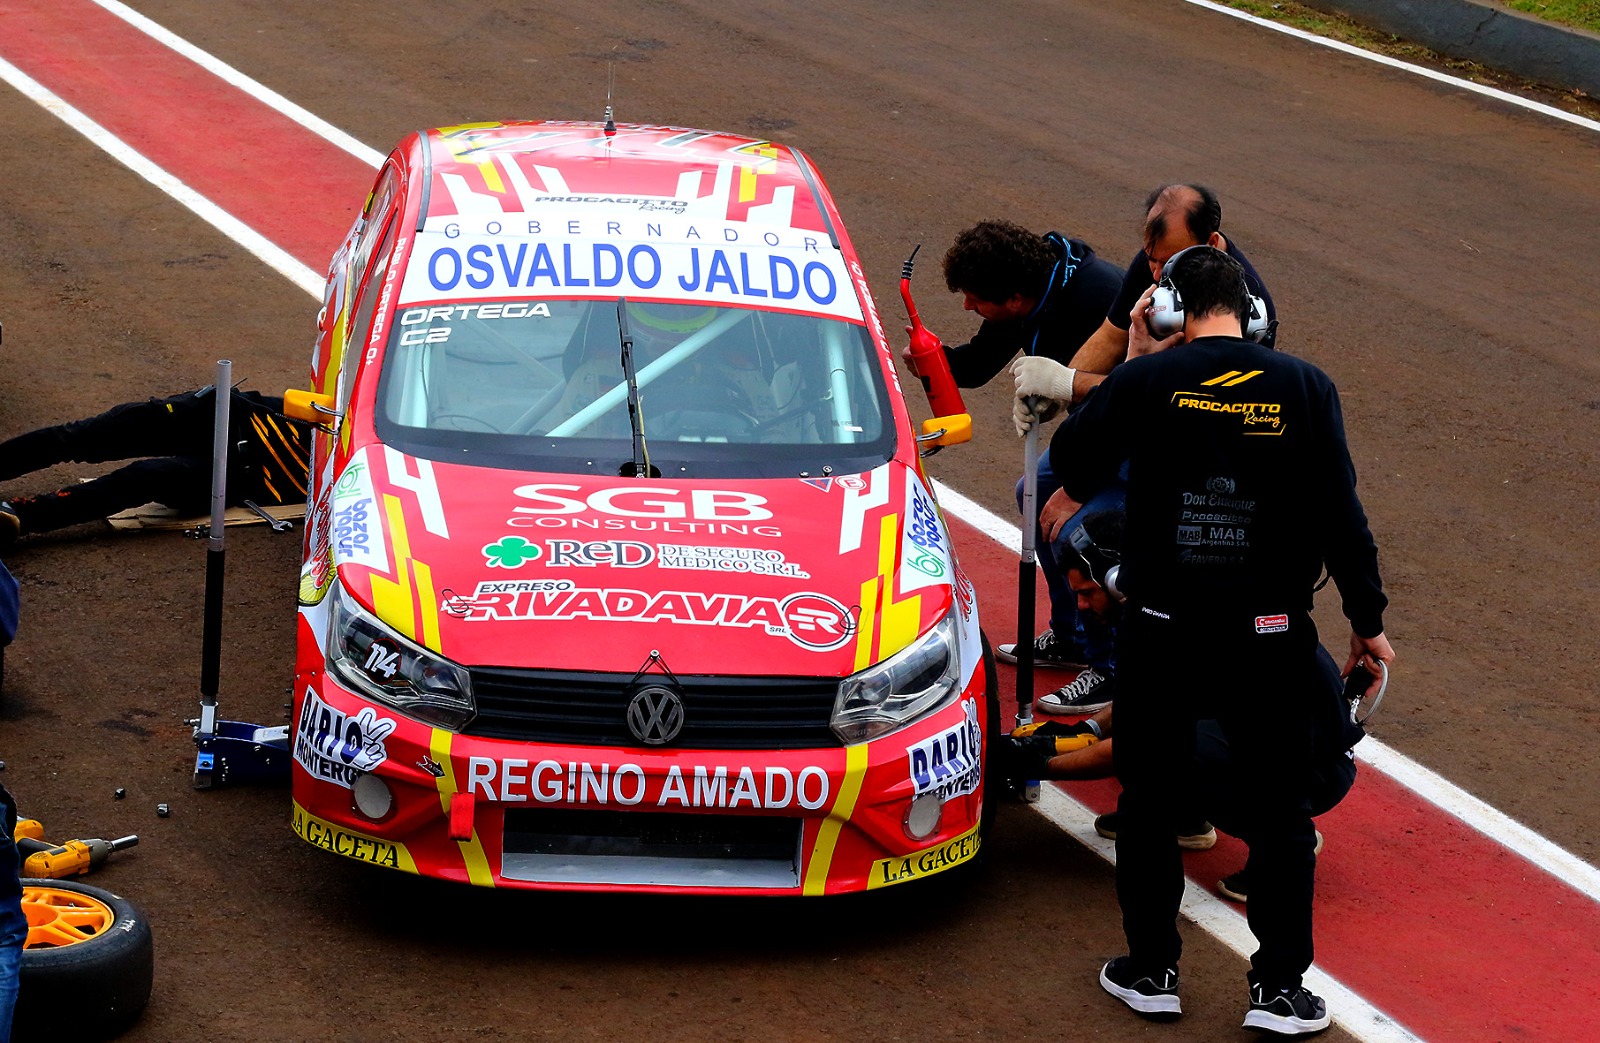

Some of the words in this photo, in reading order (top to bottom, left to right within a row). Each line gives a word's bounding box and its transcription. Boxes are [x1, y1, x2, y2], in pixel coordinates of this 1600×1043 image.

[535, 196, 689, 207] PROCACITTO
[638, 201, 686, 215] Racing
[444, 220, 822, 255] GOBERNADOR
[386, 237, 407, 281] PABLO
[428, 243, 662, 292] OSVALDO
[678, 248, 837, 306] JALDO
[369, 284, 393, 345] ORTEGA
[400, 302, 552, 327] ORTEGA
[399, 326, 452, 347] C2
[1178, 398, 1281, 413] PROCACITTO
[1243, 411, 1281, 428] Racing
[511, 483, 775, 522] SGB
[506, 516, 783, 538] CONSULTING
[1209, 527, 1246, 541] MAB
[661, 545, 692, 558] DE
[695, 547, 784, 563] SEGURO
[661, 555, 751, 572] MEDICO
[754, 562, 810, 579] S.R.L.
[479, 581, 571, 594] EXPRESO
[769, 626, 788, 634] SRL
[364, 642, 401, 679] 114
[300, 691, 363, 766] DARIO
[912, 719, 976, 791] DARIO
[468, 757, 646, 805] REGINO
[657, 765, 829, 810] AMADO
[307, 820, 399, 869] GACETA
[882, 857, 915, 884] LA
